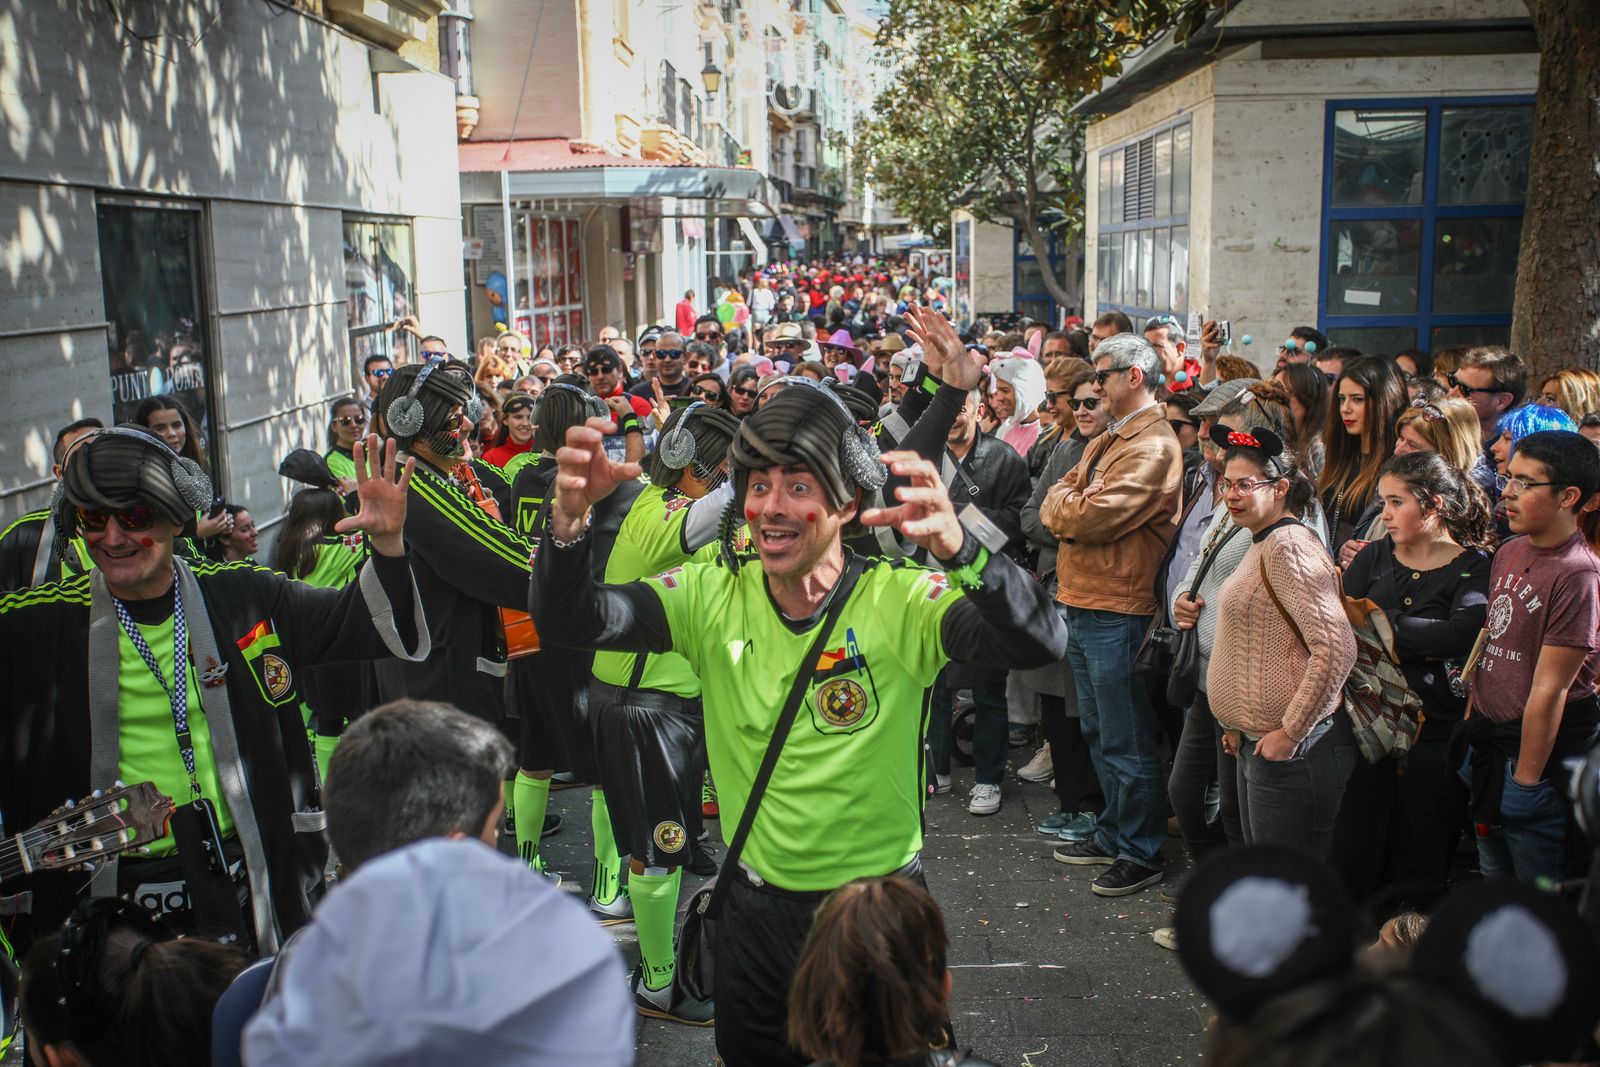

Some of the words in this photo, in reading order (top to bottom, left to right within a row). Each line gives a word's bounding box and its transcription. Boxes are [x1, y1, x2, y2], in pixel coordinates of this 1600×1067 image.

[1494, 573, 1543, 614] ARLEM
[1506, 649, 1521, 662] INC
[652, 962, 675, 974] KIP
